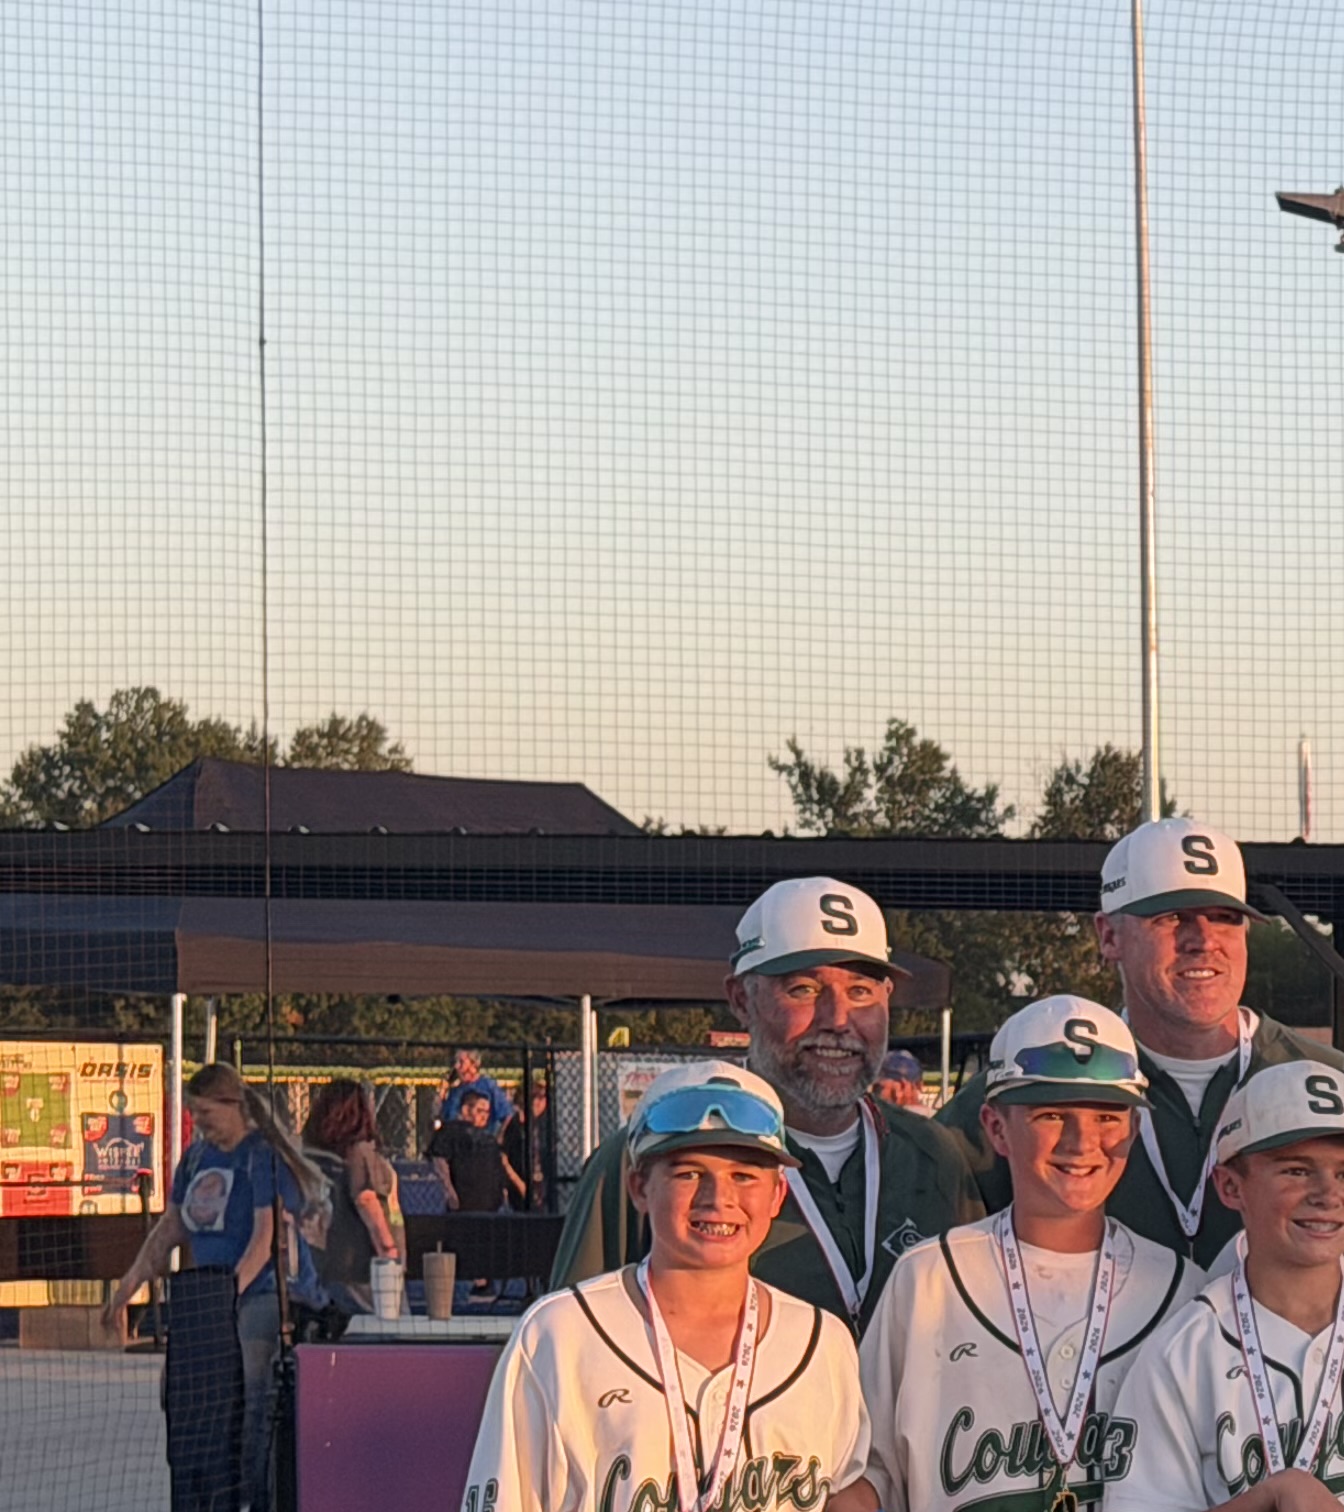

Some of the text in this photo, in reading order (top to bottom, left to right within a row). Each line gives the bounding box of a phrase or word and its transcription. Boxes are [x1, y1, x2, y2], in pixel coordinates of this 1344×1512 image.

[1182, 835, 1219, 876] S
[820, 893, 858, 936] S
[80, 1062, 153, 1078] OASIS
[1306, 1075, 1344, 1115] S
